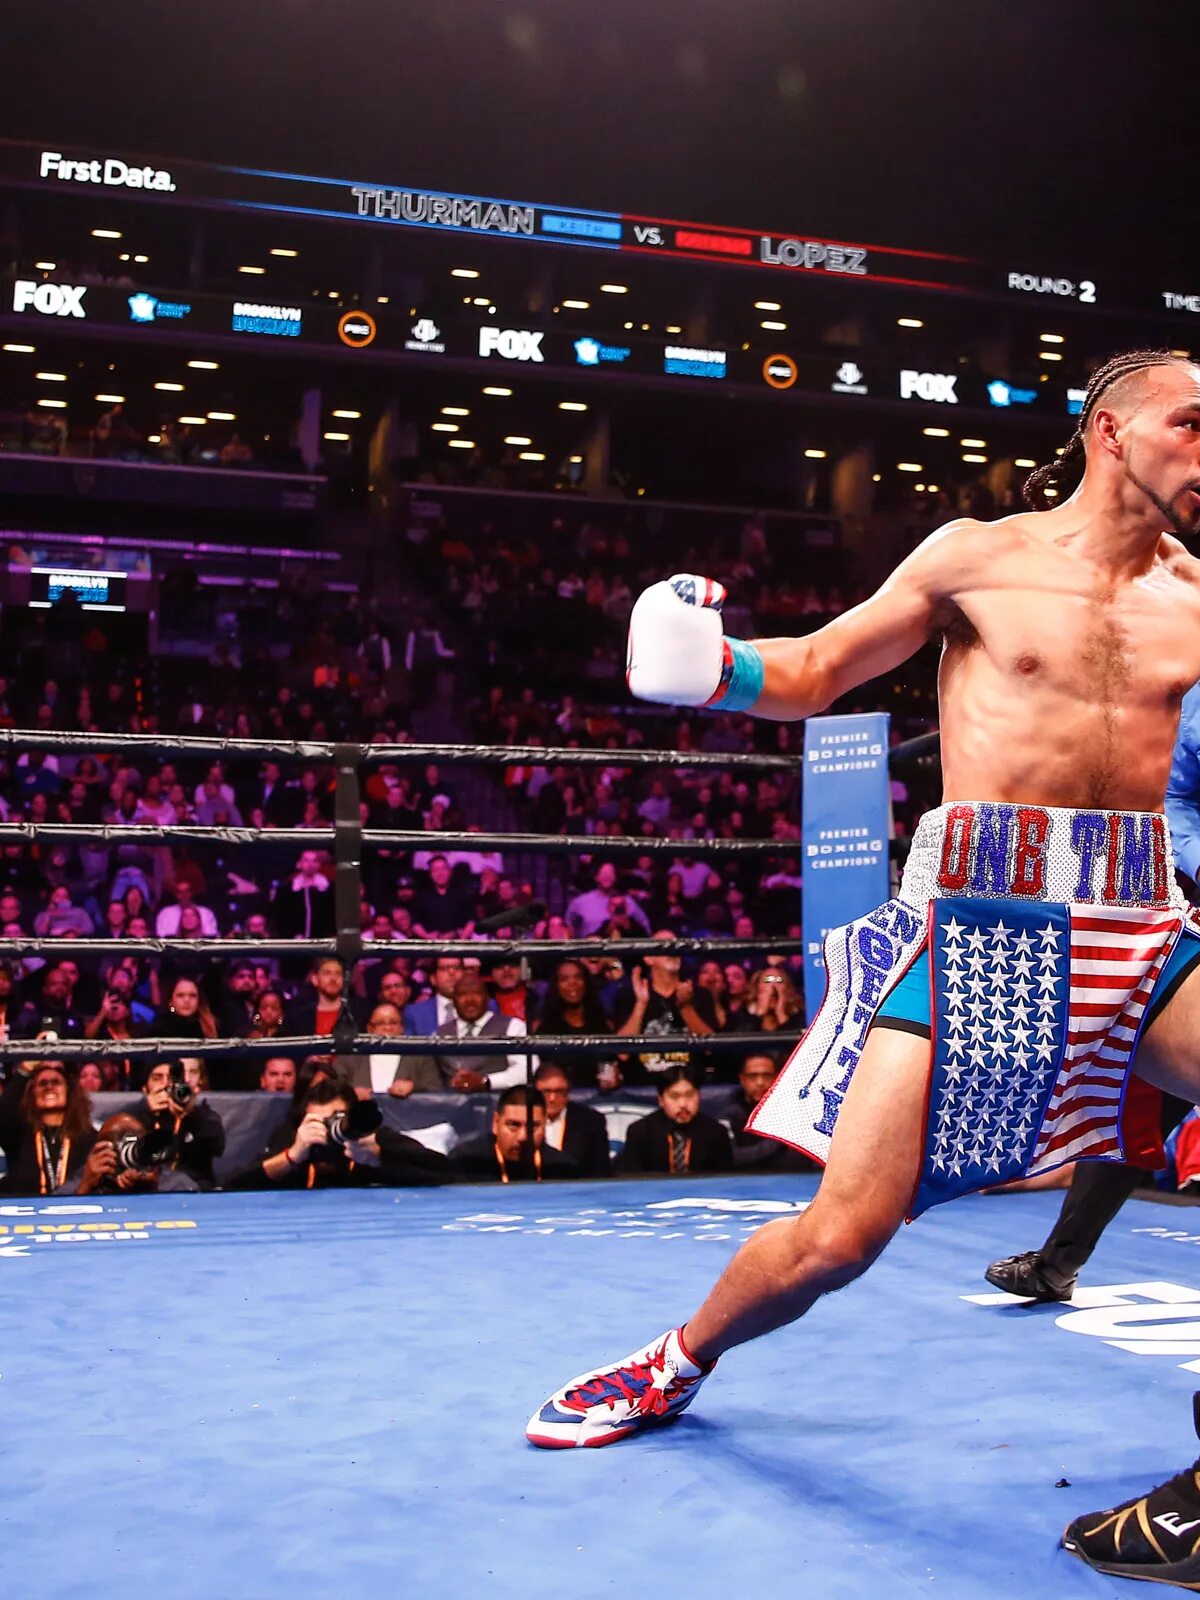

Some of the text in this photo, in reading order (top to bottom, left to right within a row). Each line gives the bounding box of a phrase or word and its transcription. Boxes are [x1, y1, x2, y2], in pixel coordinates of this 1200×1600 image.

[40, 152, 101, 182] First
[351, 185, 534, 234] THURMAN
[633, 225, 665, 246] VS.
[760, 236, 868, 275] LOPEZ
[13, 280, 86, 318] FOX
[1008, 272, 1096, 303] ROUND: 2
[233, 302, 302, 322] BROOKLYN
[479, 326, 545, 362] FOX
[900, 369, 959, 404] FOX
[820, 732, 869, 745] PREMIER
[808, 743, 883, 761] BOXING
[812, 760, 878, 774] CHAMPIONS
[820, 828, 869, 841] PREMIER
[808, 839, 883, 857] BOXING
[936, 803, 1051, 898] ONE
[812, 856, 878, 870] CHAMPIONS
